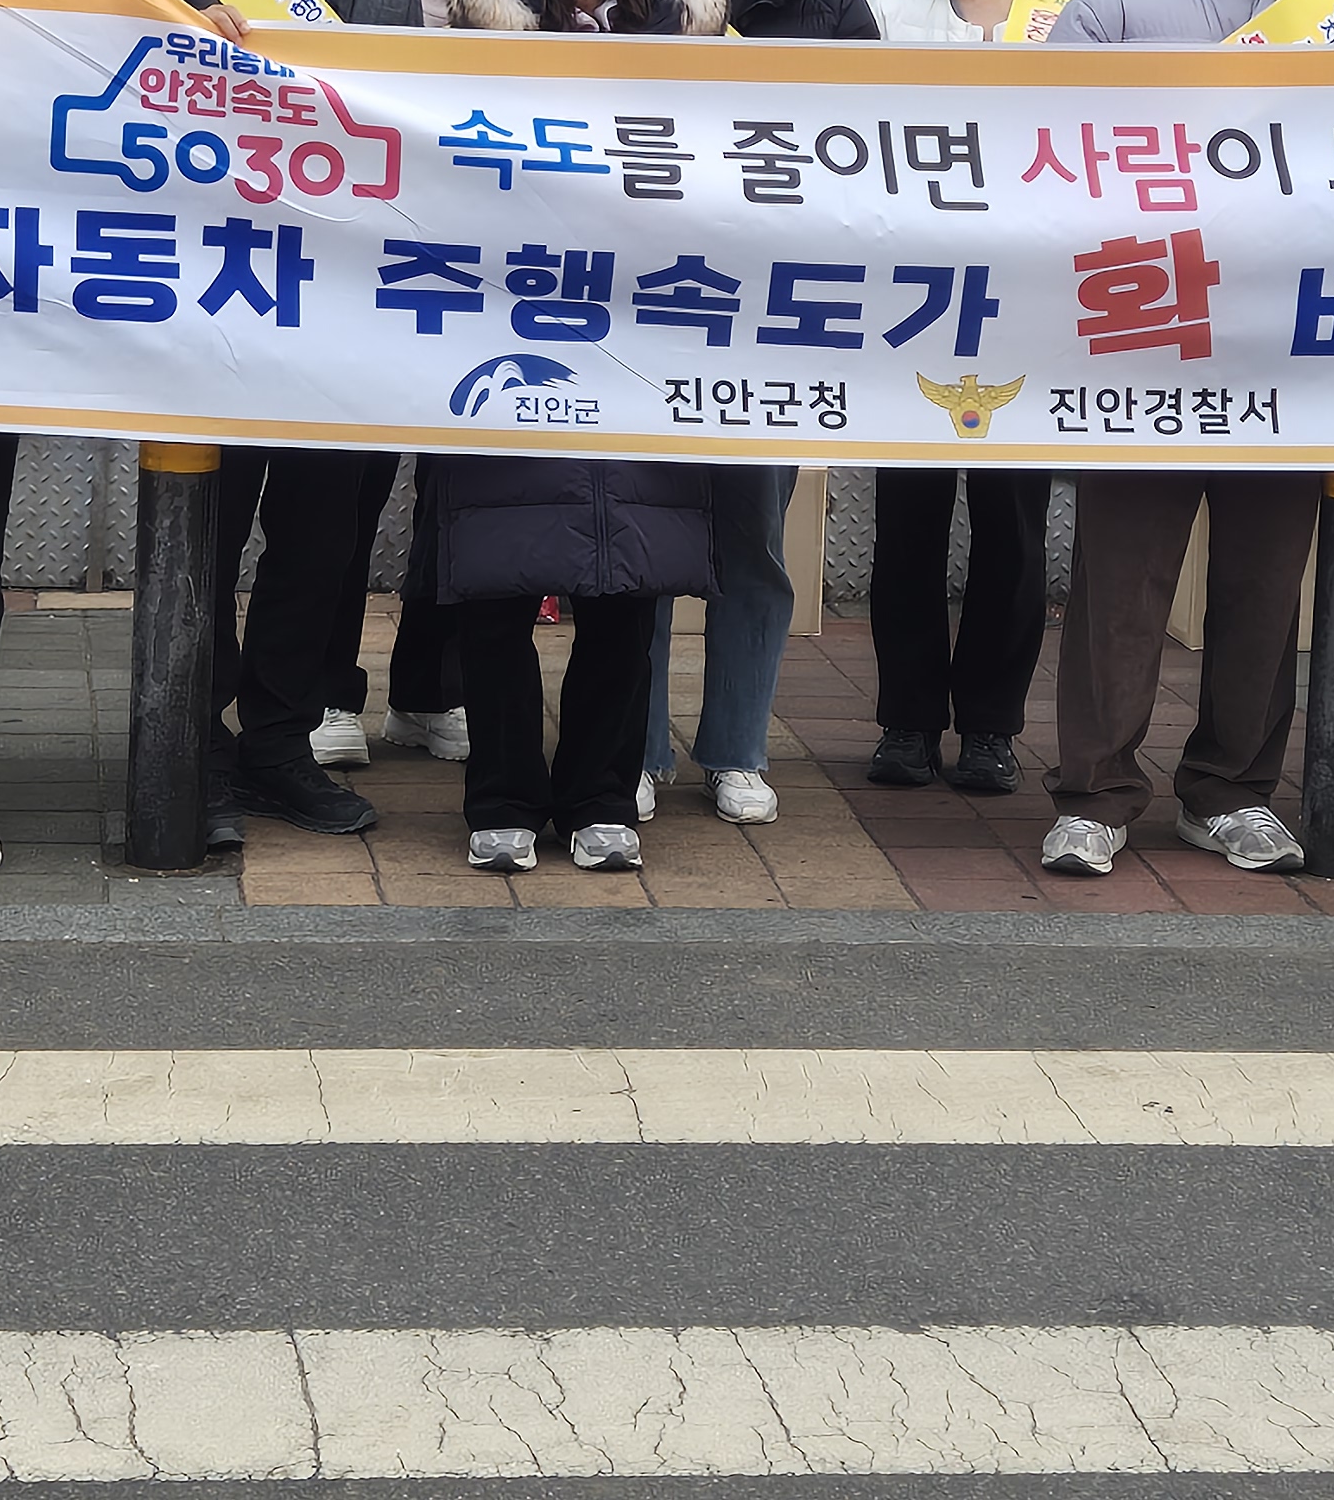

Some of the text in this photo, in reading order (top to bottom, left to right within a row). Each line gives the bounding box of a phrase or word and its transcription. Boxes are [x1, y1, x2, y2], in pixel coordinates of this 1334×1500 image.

[139, 66, 319, 127] 안전속도
[120, 120, 346, 205] 5030
[438, 108, 695, 202] 속도를
[722, 119, 989, 212] 줄이면
[1020, 121, 1293, 212] 사람이
[373, 237, 1001, 360] 주행속도가
[1072, 227, 1221, 362] 확
[514, 395, 601, 426] 진안군
[663, 376, 1281, 436] 진안군청 진안경찰서
